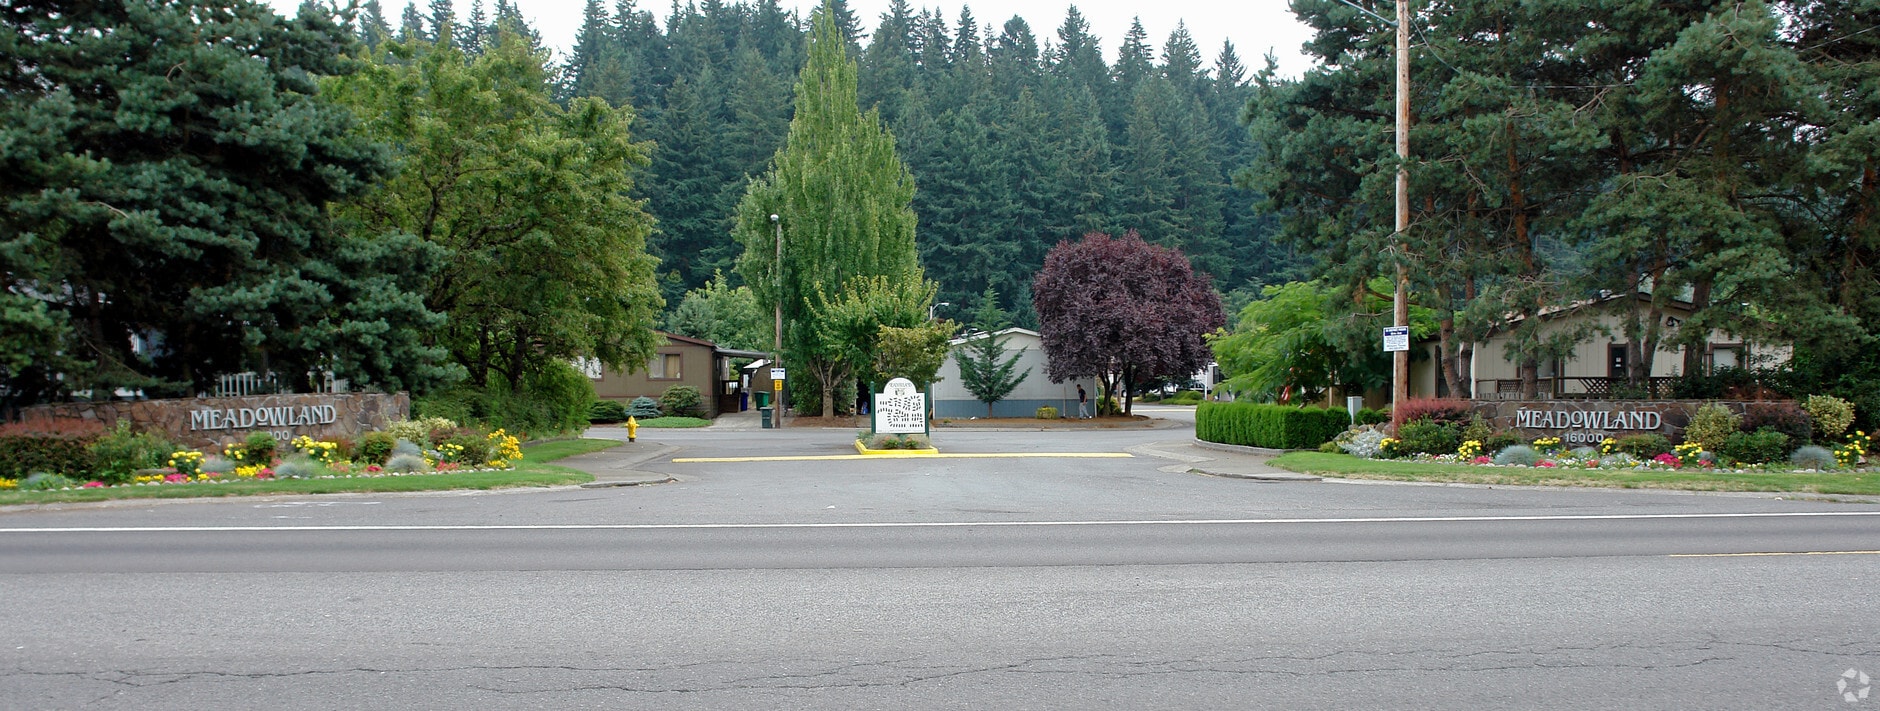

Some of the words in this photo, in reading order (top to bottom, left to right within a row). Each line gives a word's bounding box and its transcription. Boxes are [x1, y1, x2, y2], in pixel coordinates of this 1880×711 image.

[190, 405, 336, 430] MEADOWLAND
[1516, 410, 1661, 430] MEADOWLAND
[1565, 433, 1604, 443] 16000
